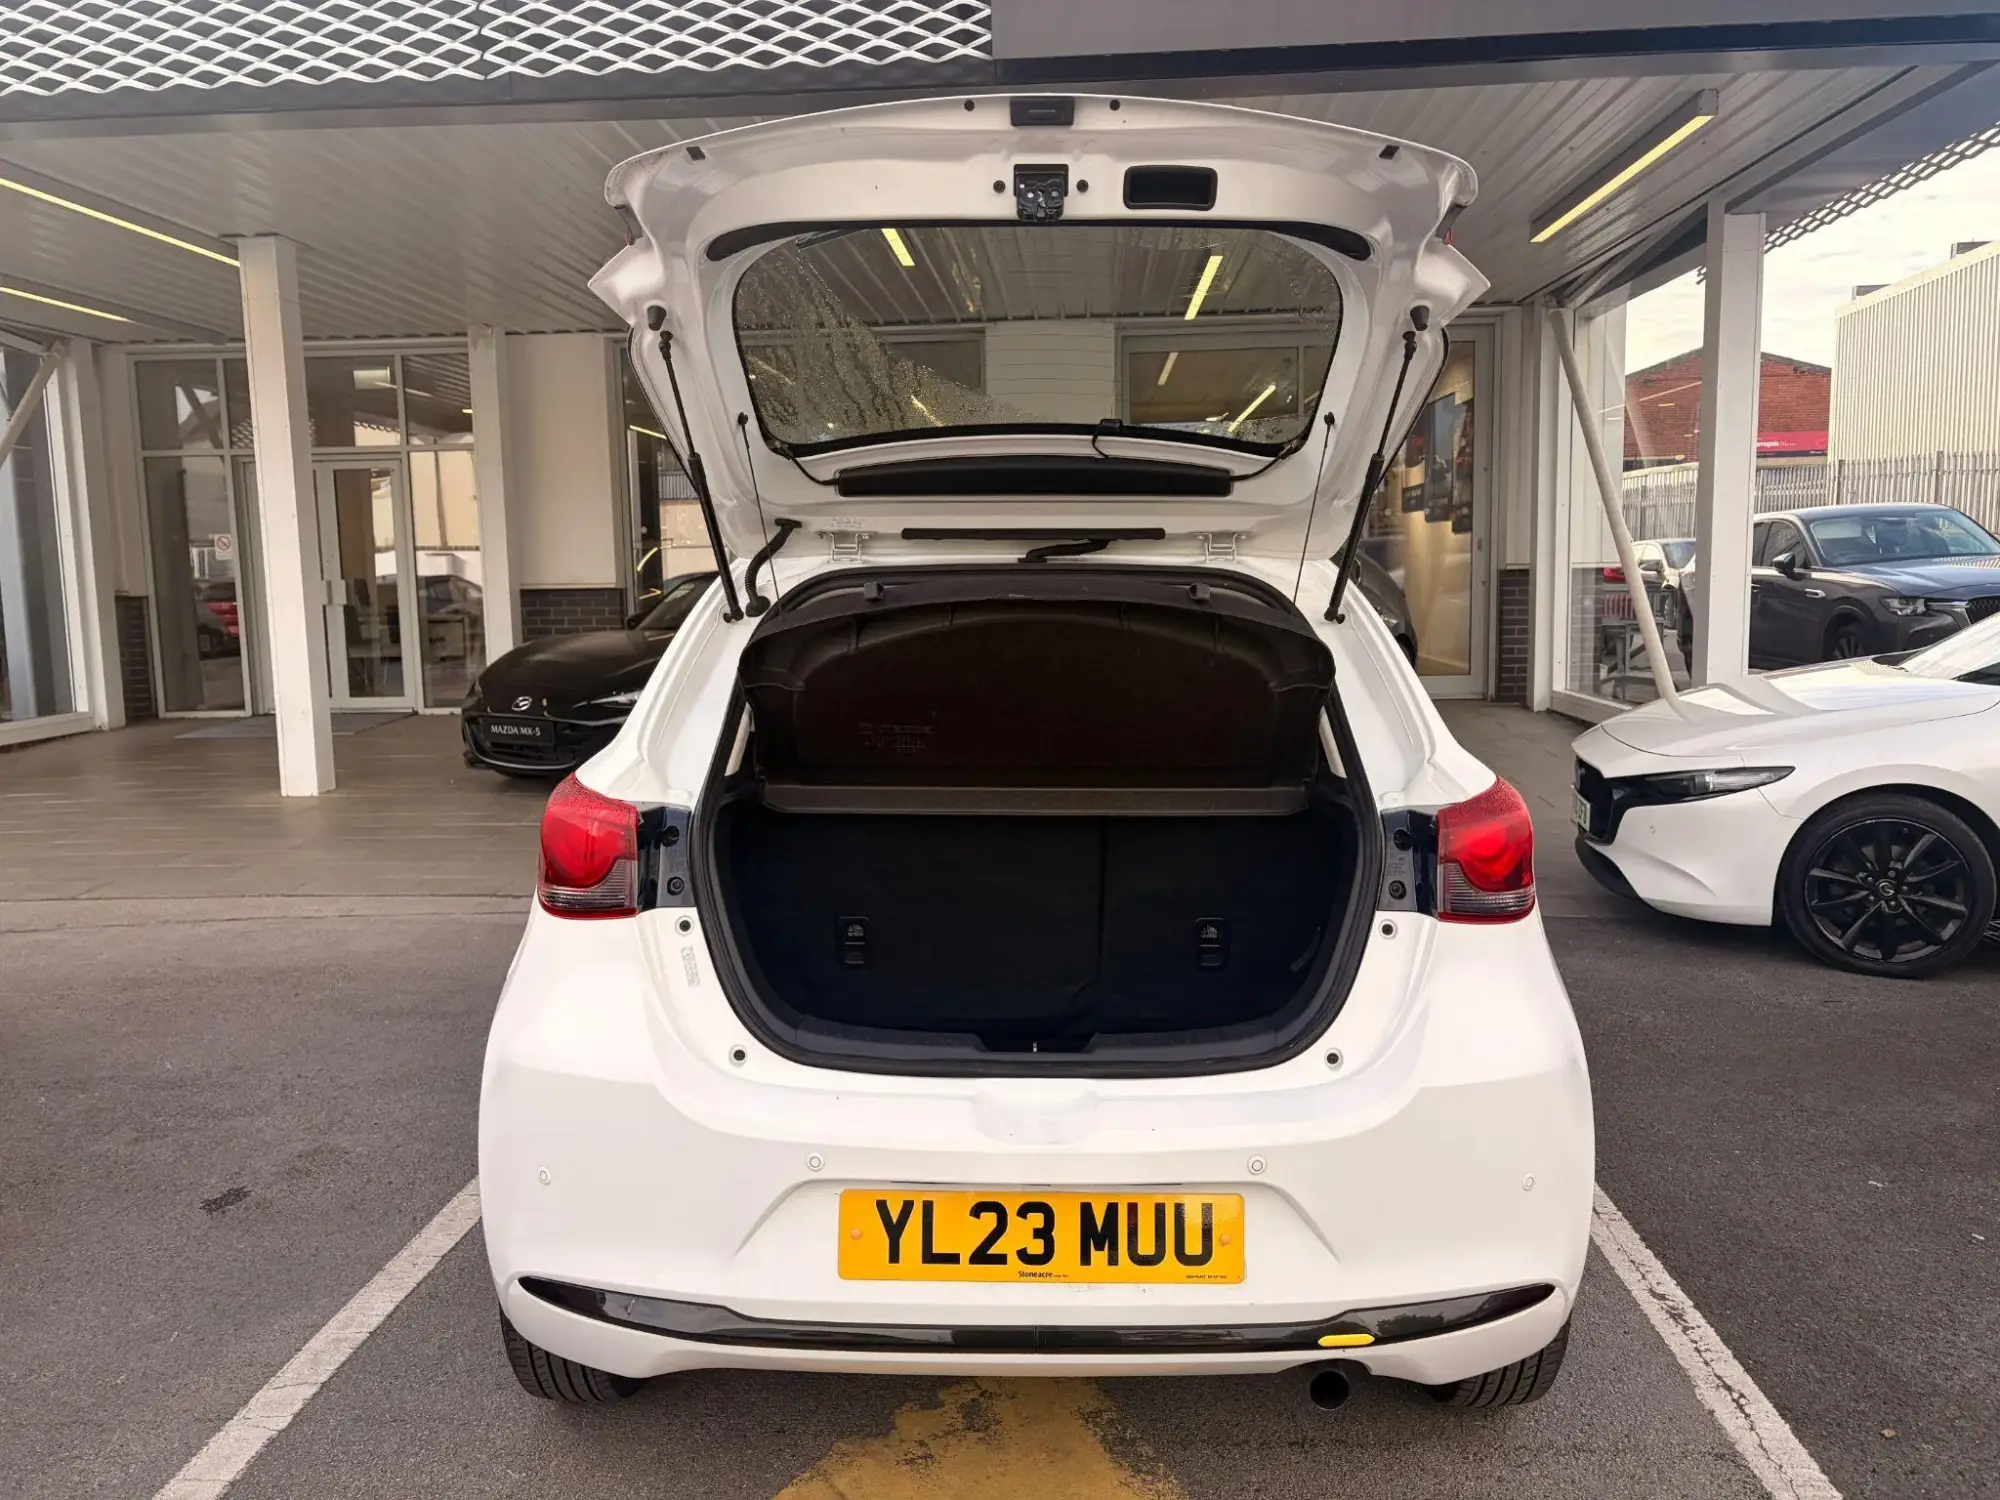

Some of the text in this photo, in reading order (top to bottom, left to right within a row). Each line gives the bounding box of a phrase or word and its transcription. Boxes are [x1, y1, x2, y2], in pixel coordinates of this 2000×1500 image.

[490, 724, 541, 737] MAZDA MX-5
[875, 1199, 1214, 1267] YL23 MUU
[1018, 1270, 1053, 1278] Stoneacre
